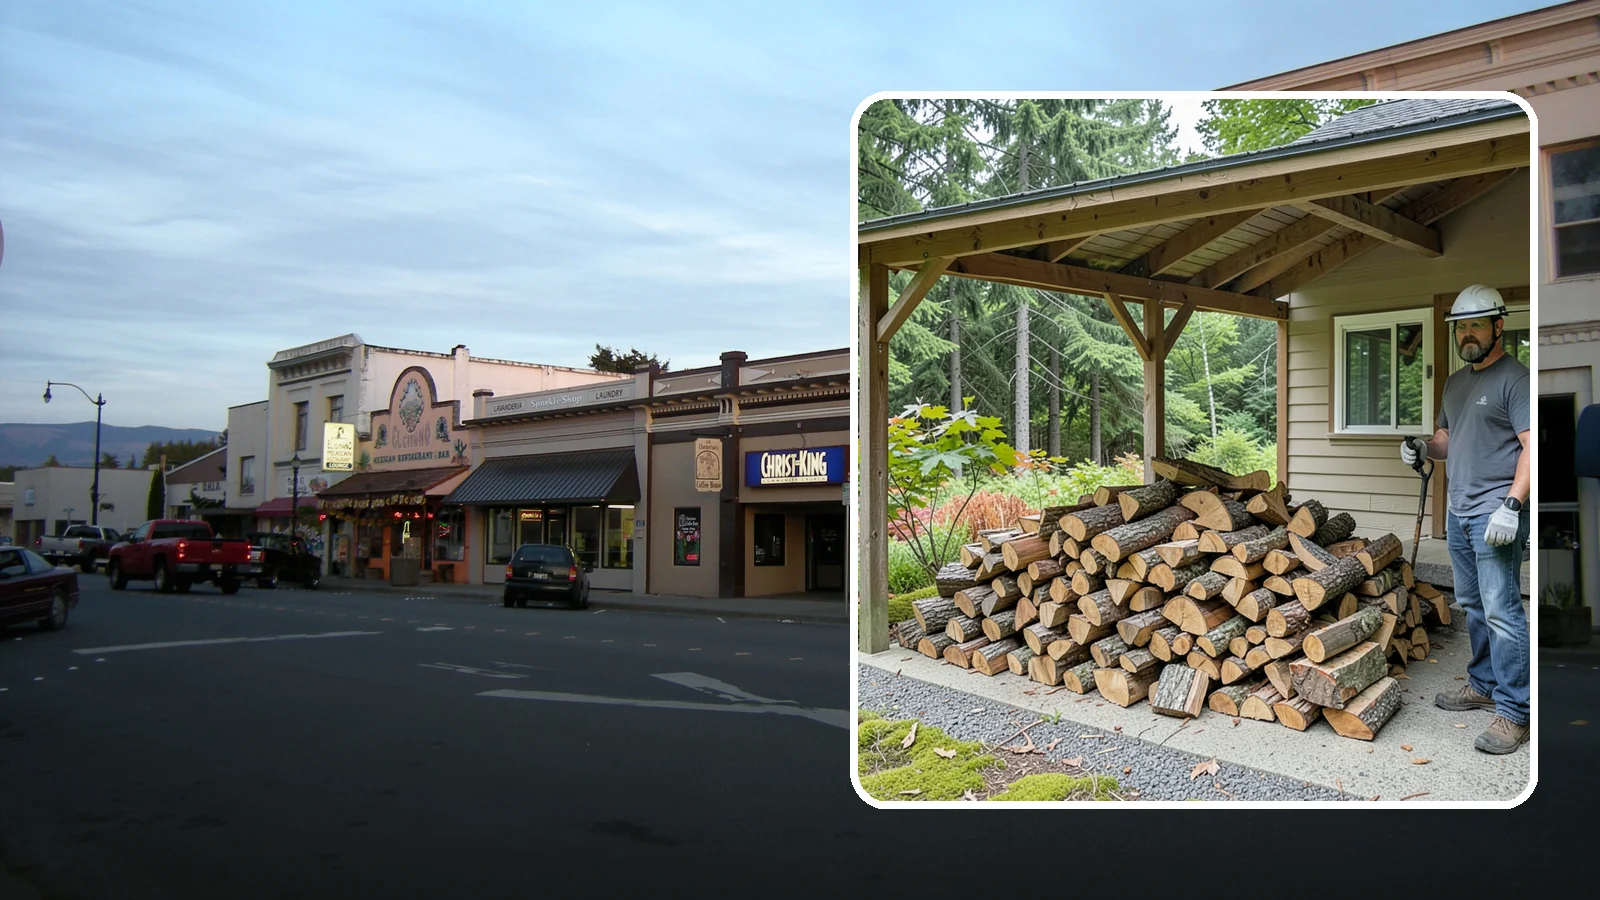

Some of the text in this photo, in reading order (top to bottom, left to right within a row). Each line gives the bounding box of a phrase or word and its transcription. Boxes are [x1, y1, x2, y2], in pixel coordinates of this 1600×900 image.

[595, 389, 623, 399] LAUNDRY
[493, 402, 522, 412] LAVANDERIA
[530, 394, 582, 409] Sparkle Shop
[397, 452, 433, 462] RESTAURANT
[438, 450, 450, 459] BAR
